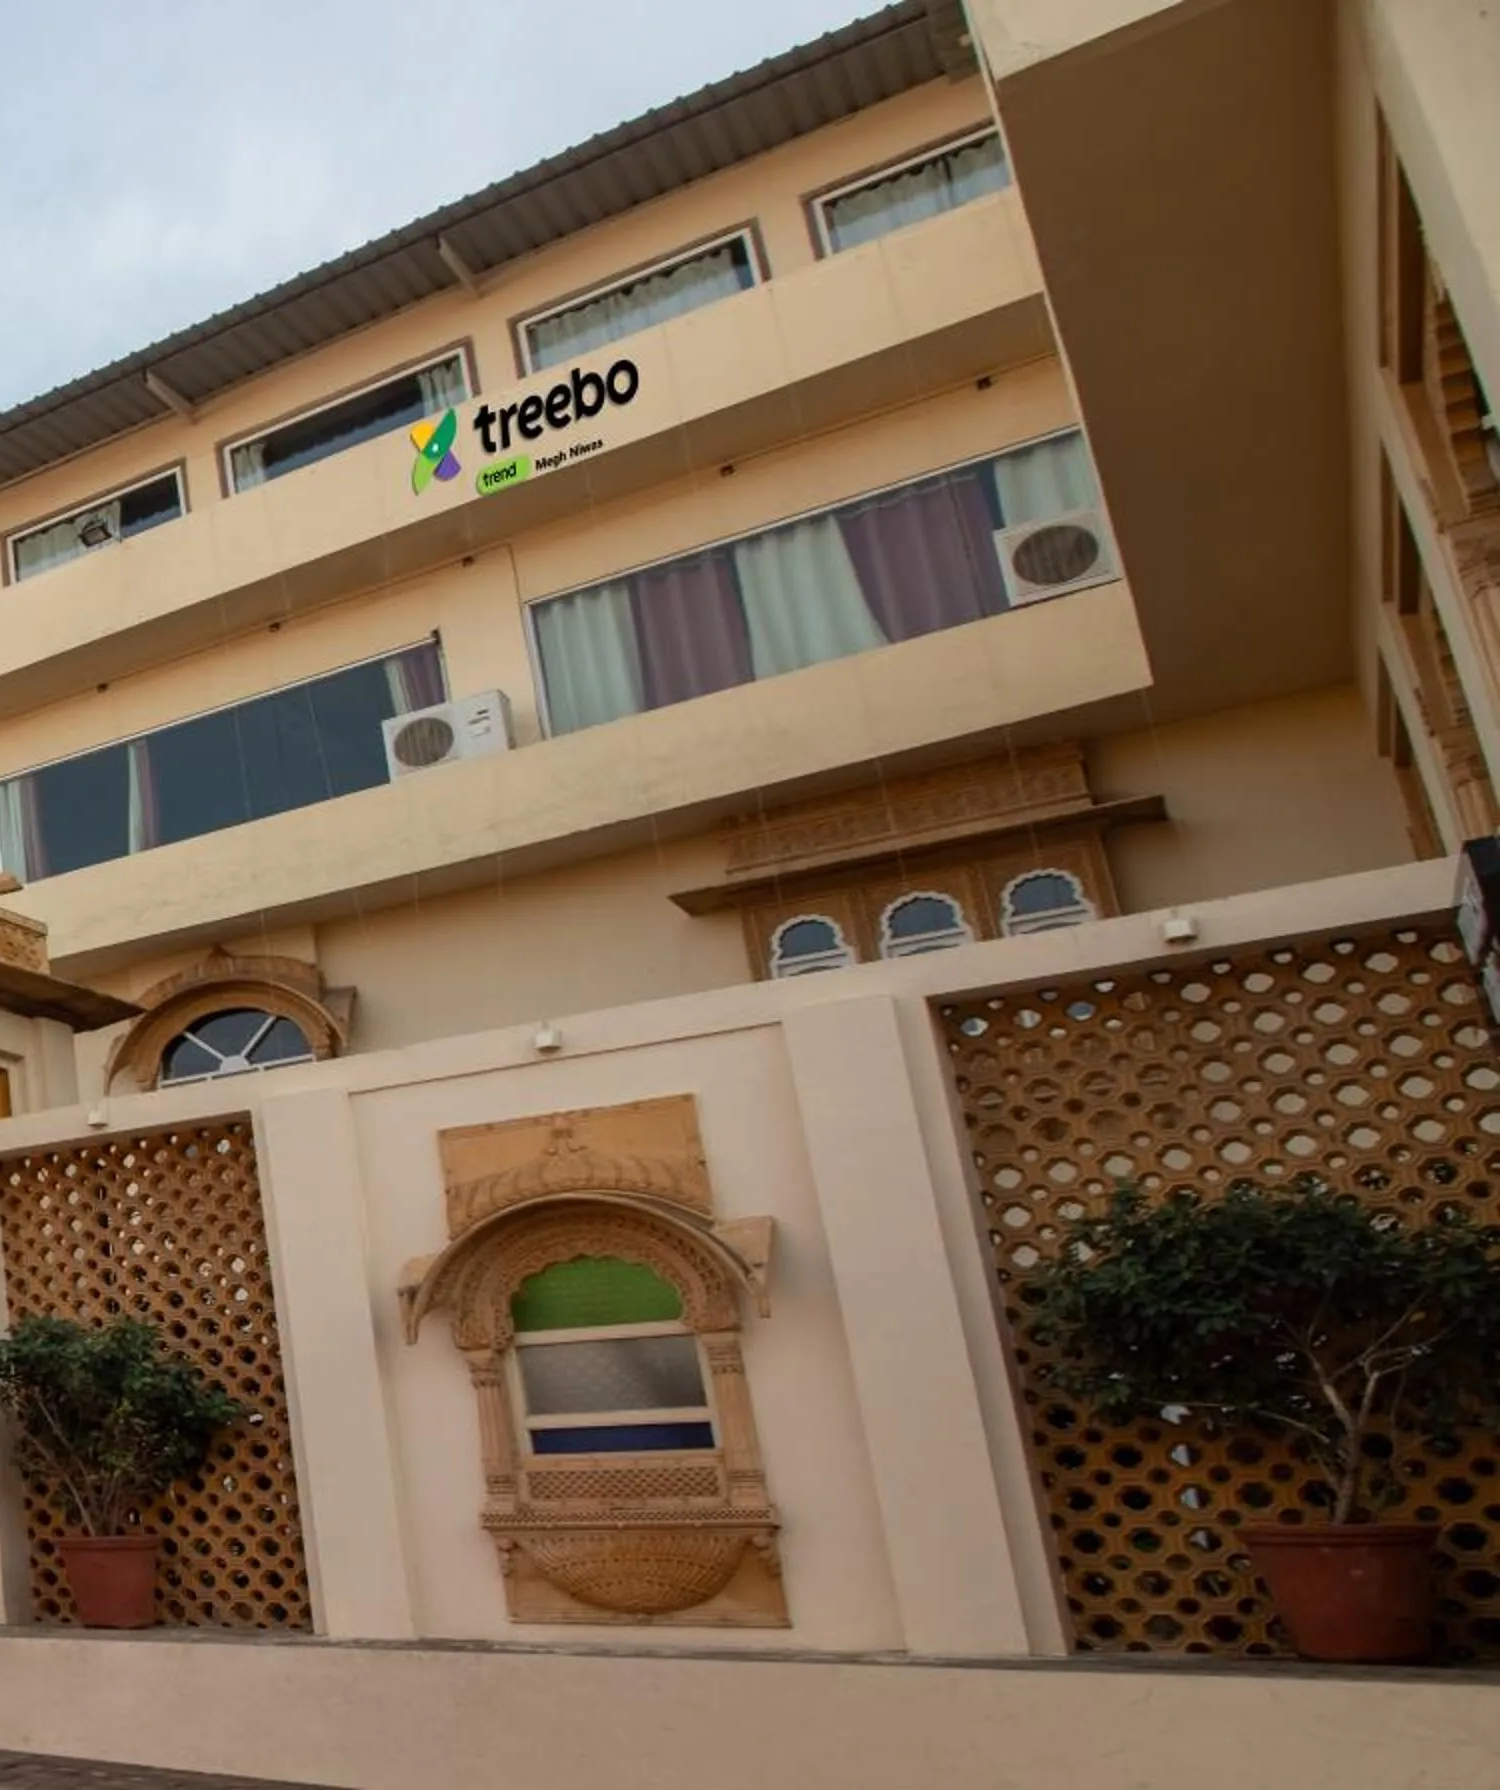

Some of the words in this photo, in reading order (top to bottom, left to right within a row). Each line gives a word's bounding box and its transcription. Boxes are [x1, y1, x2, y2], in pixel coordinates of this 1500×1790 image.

[473, 359, 639, 453] treebo
[535, 450, 567, 471] Megh
[483, 462, 517, 487] trend
